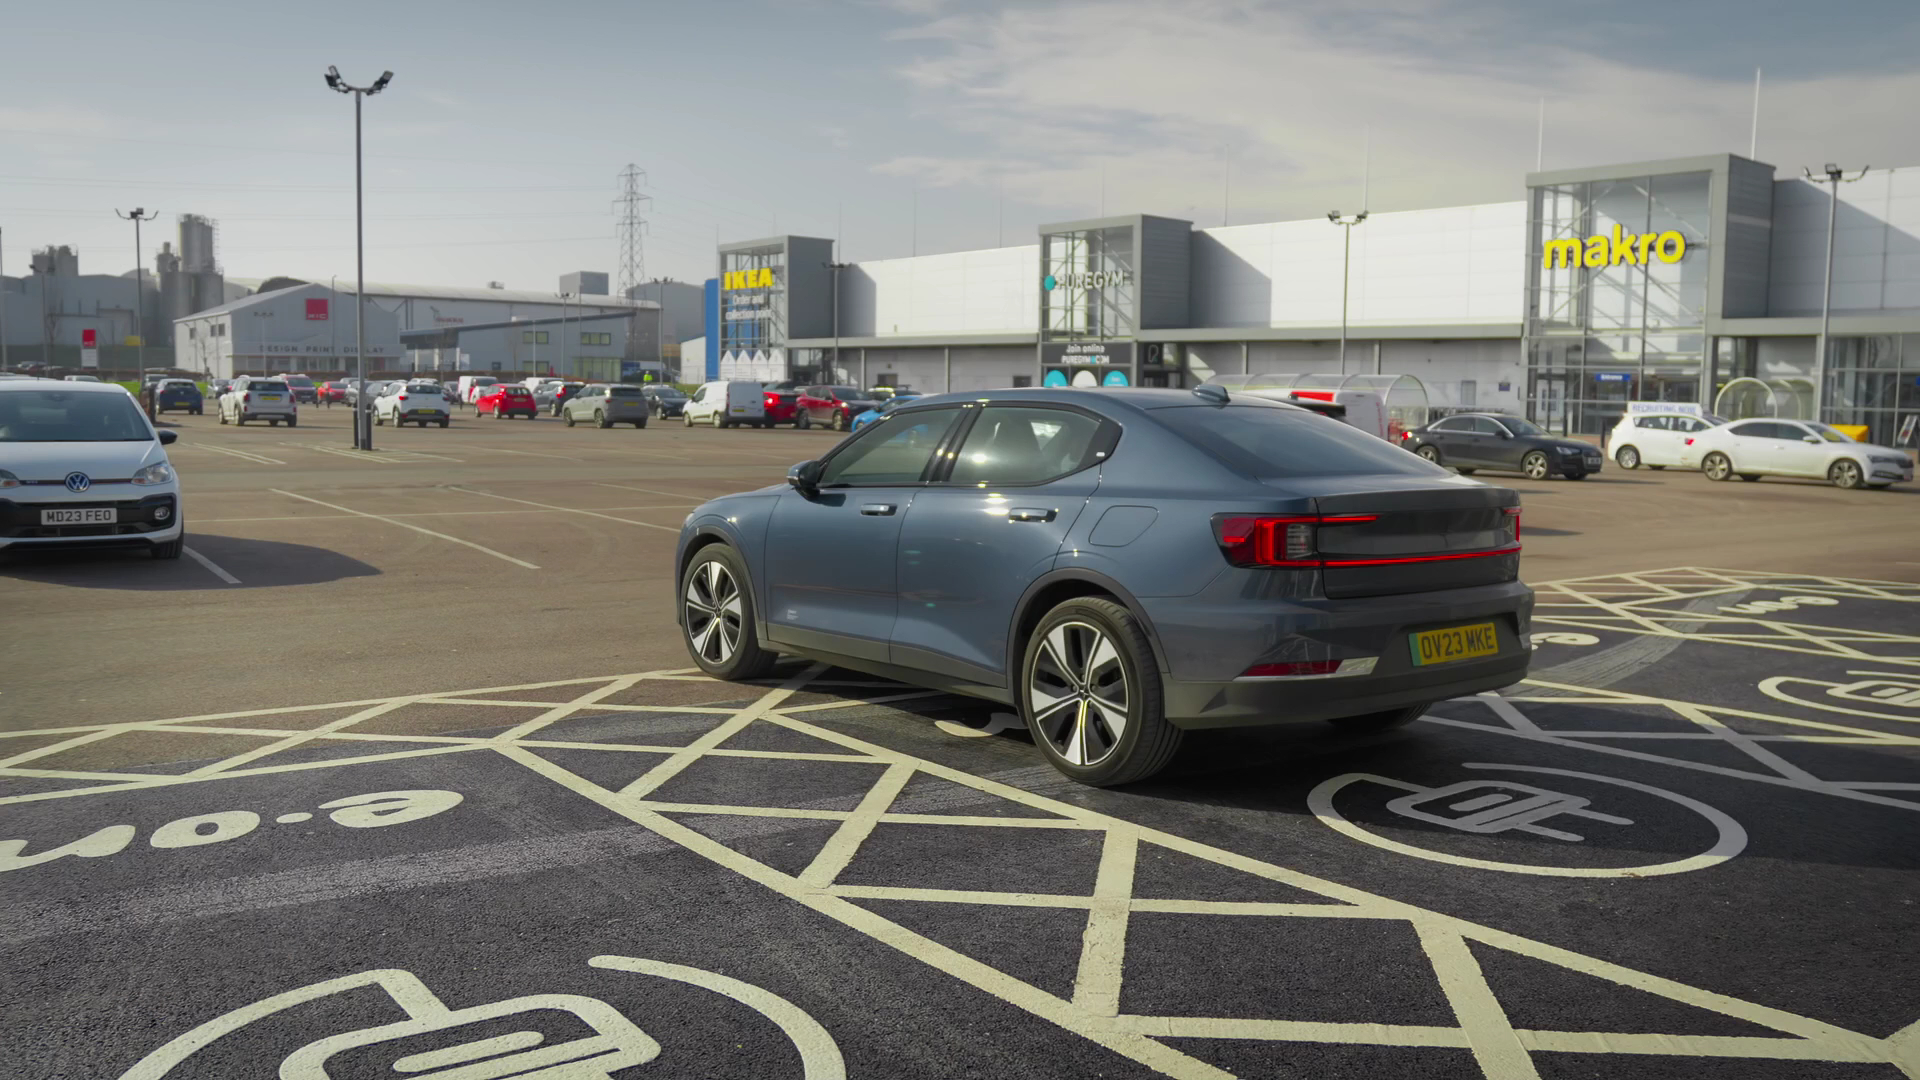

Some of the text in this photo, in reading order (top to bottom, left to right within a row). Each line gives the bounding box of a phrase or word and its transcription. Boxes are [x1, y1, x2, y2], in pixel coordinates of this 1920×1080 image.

[1543, 223, 1686, 270] makro
[724, 267, 773, 290] IKEA
[1057, 270, 1124, 290] PUREGYM
[733, 295, 764, 305] Order and
[725, 309, 773, 320] collection point
[260, 345, 385, 354] DESIGN PRINT DISLAY
[1066, 343, 1105, 353] Join online
[46, 510, 82, 522] MD23
[1421, 626, 1495, 659] OV23 MKE
